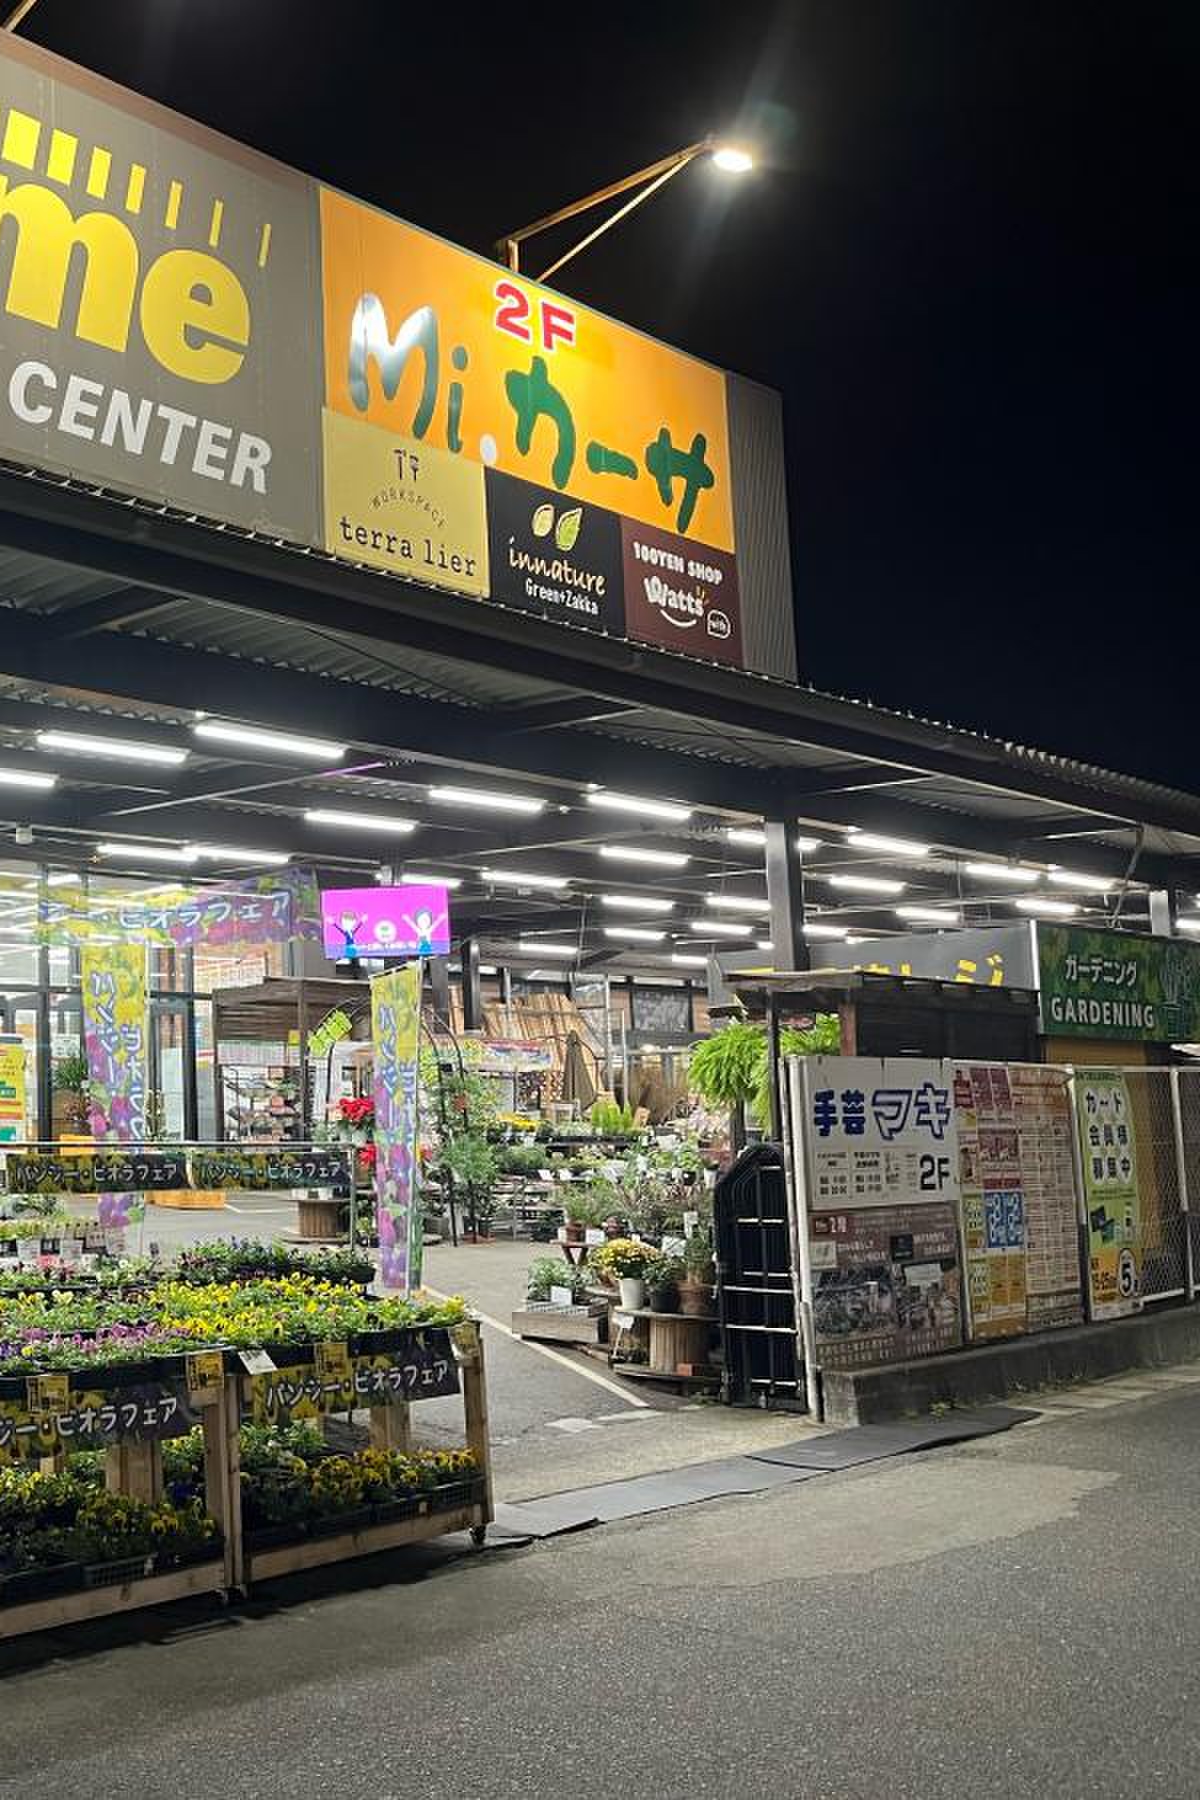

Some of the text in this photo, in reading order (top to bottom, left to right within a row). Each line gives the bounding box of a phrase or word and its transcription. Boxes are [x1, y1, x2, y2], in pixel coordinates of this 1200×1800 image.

[495, 281, 575, 350] 2F
[7, 361, 273, 495] CENTER
[340, 516, 477, 577] terra lier
[508, 536, 606, 596] innature
[687, 560, 723, 585] SHOP
[643, 576, 704, 617] Watts
[1065, 954, 1137, 987] ガーデニング
[1051, 998, 1155, 1028] GARDENING
[1086, 1091, 1122, 1114] カード
[920, 1154, 949, 1191] 2F
